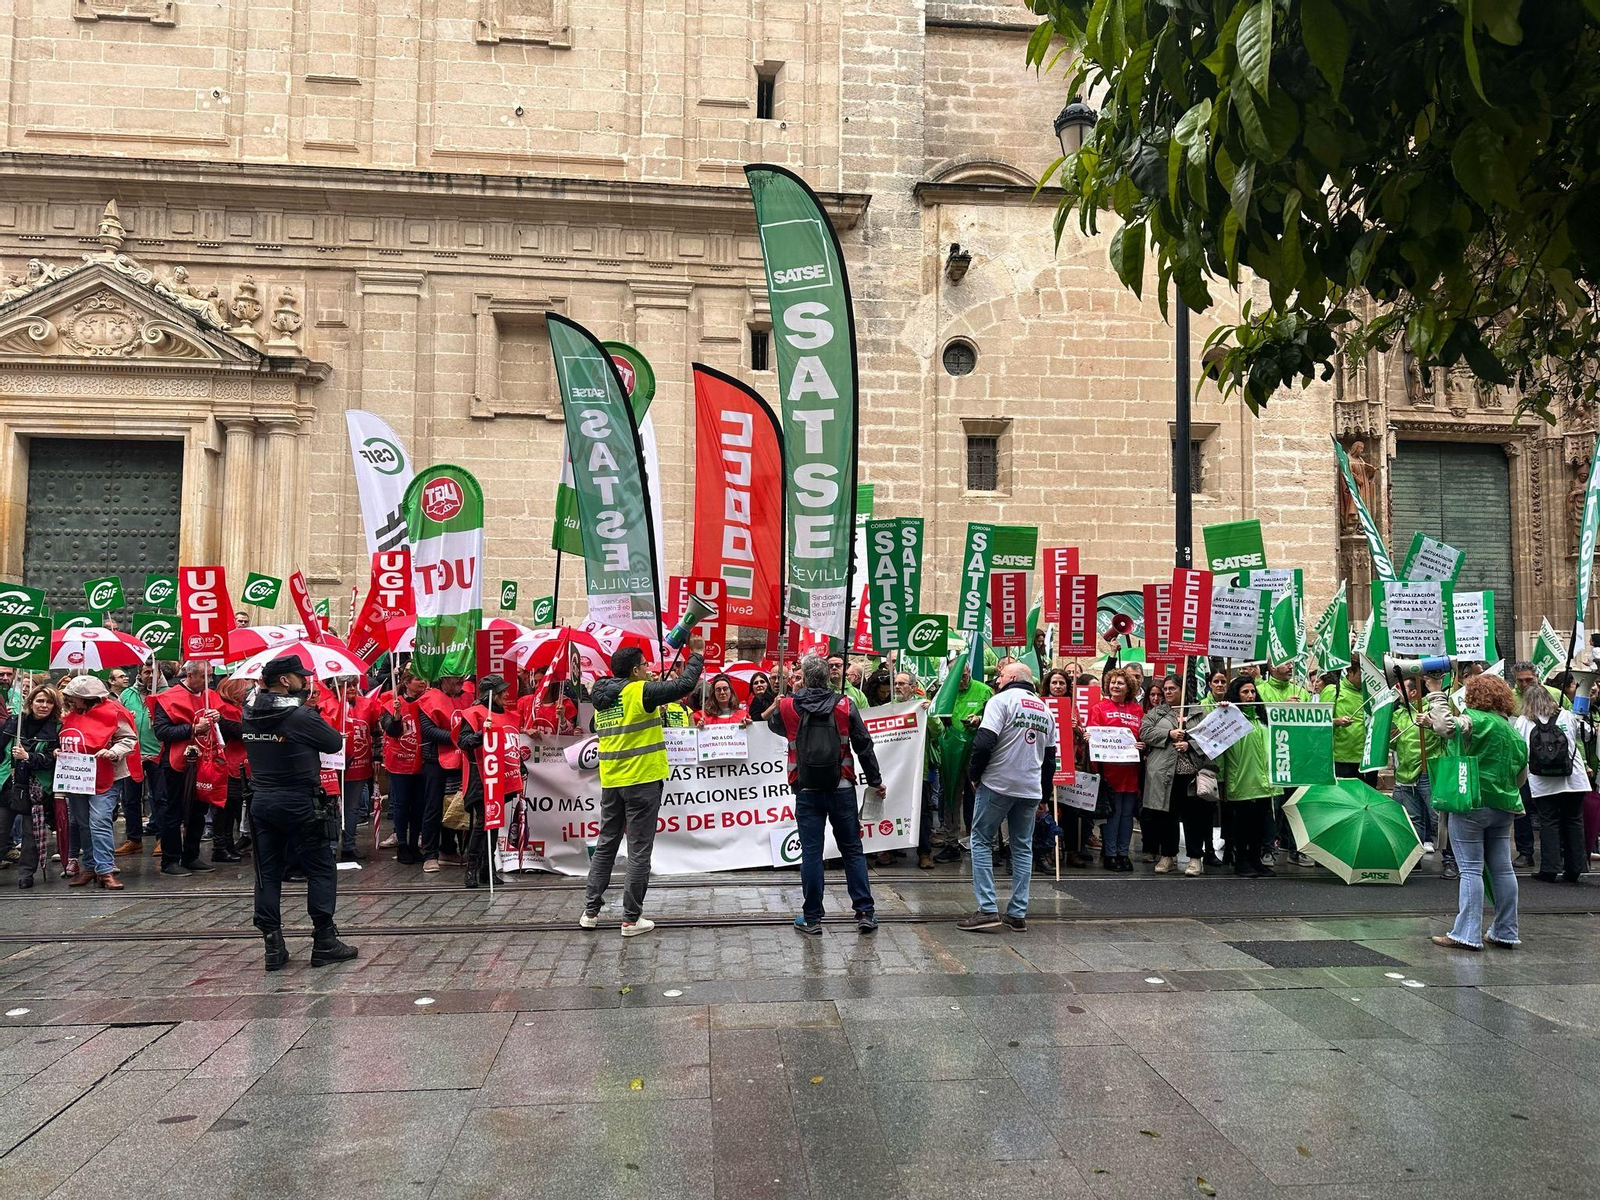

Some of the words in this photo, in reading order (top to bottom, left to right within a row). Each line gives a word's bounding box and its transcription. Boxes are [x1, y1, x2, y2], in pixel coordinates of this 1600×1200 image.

[773, 264, 825, 284] SATSE
[783, 301, 840, 559] SATSE
[991, 554, 1033, 567] SATSE
[1212, 553, 1263, 571] SATSE
[1420, 562, 1434, 570] BOLSA
[901, 527, 917, 612] SATS
[379, 554, 404, 607] UGT
[963, 532, 988, 630] SATSE
[94, 587, 118, 601] CSIF
[151, 585, 174, 597] CSIF
[250, 585, 276, 596] CSIF
[874, 531, 900, 649] SATSE
[187, 570, 218, 634] UGT
[1002, 575, 1016, 624] CCOO
[1071, 576, 1085, 631] CCOO
[1182, 571, 1200, 628] CCOO
[1156, 585, 1170, 639] CCOO
[6, 633, 45, 650] CSIF
[146, 630, 175, 645] CSIF
[914, 628, 944, 641] CSIF
[1023, 700, 1044, 710] CCOO
[1027, 714, 1049, 725] JUNTA
[1106, 712, 1131, 720] CCOO
[1270, 707, 1333, 723] GRANADA
[867, 717, 905, 732] CCOO
[242, 733, 280, 742] POLICIA
[584, 750, 600, 763] CS
[1275, 729, 1291, 783] SATSE
[484, 732, 498, 800] UGT
[696, 760, 784, 779] RETRASOS
[1459, 762, 1467, 794] SATSE
[1076, 790, 1095, 798] BASURA
[525, 796, 554, 812] NO
[558, 796, 595, 812] MÁS
[686, 813, 716, 832] DE
[721, 805, 795, 828] BOLSA
[787, 840, 803, 852] CS
[1361, 871, 1389, 880] SATSE
